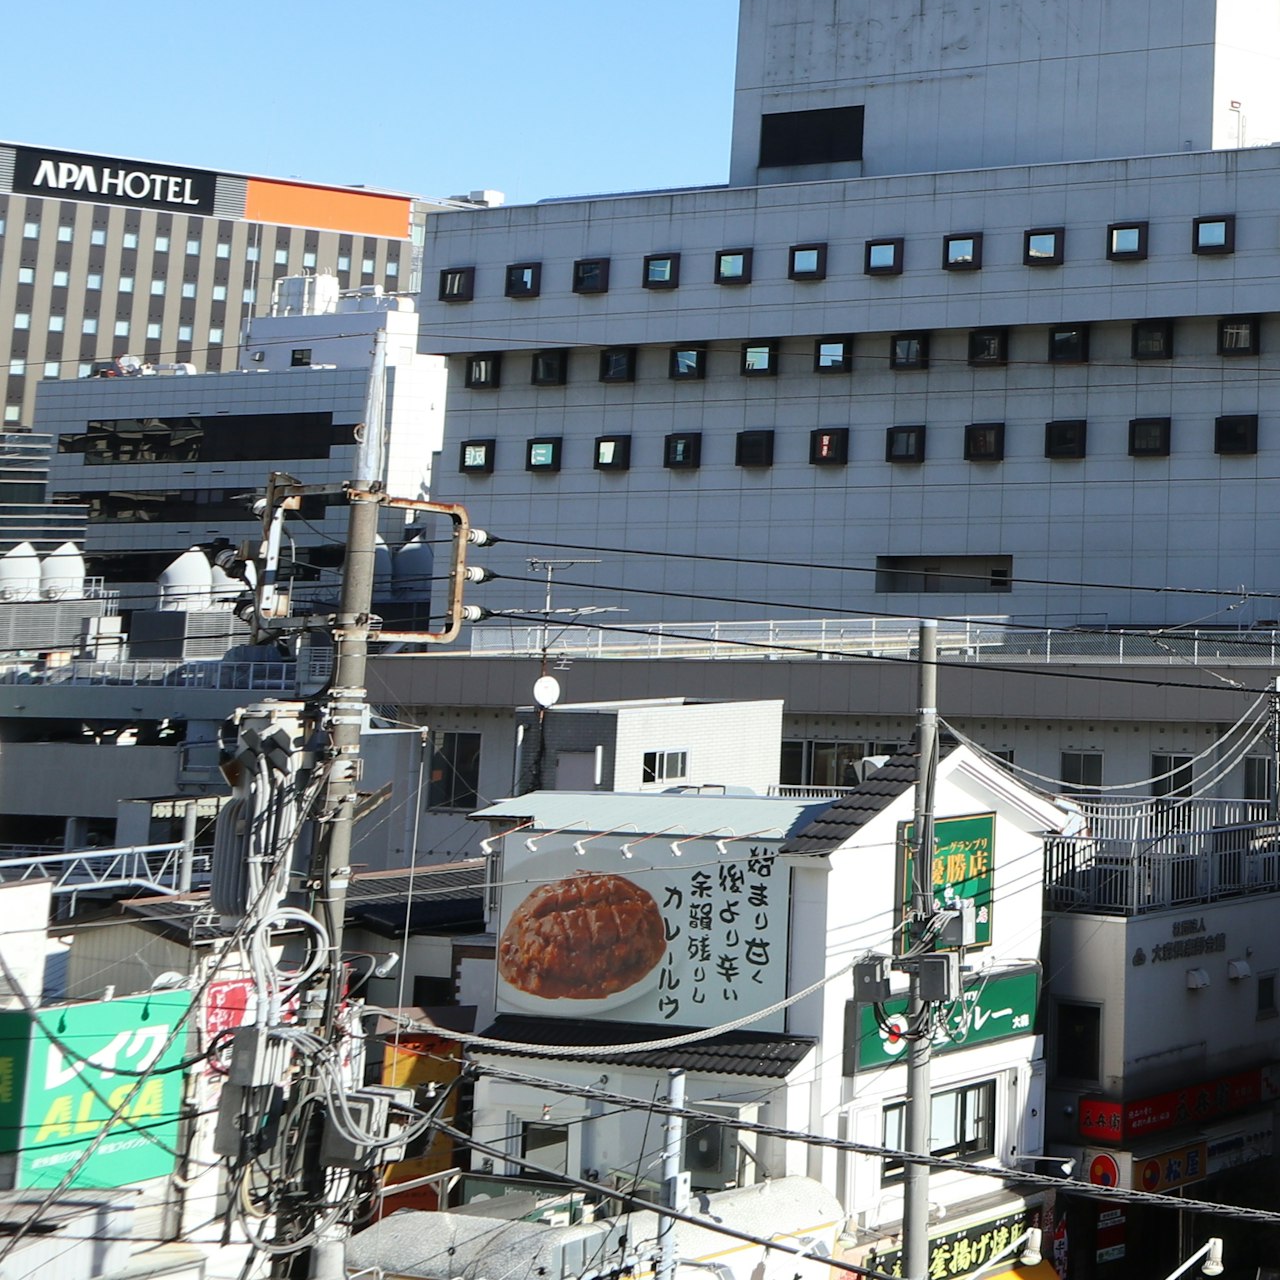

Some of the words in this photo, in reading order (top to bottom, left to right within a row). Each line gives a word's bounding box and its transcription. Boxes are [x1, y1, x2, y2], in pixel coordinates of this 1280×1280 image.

[33, 159, 98, 193] APA
[100, 168, 199, 205] HOTEL
[716, 863, 745, 1001] 後より辛い
[745, 846, 774, 984] 始まり甘く
[659, 886, 683, 1020] カレールウ
[44, 1024, 170, 1090] レイク
[33, 1078, 165, 1144] ALSA
[1165, 1150, 1200, 1183] 松屋
